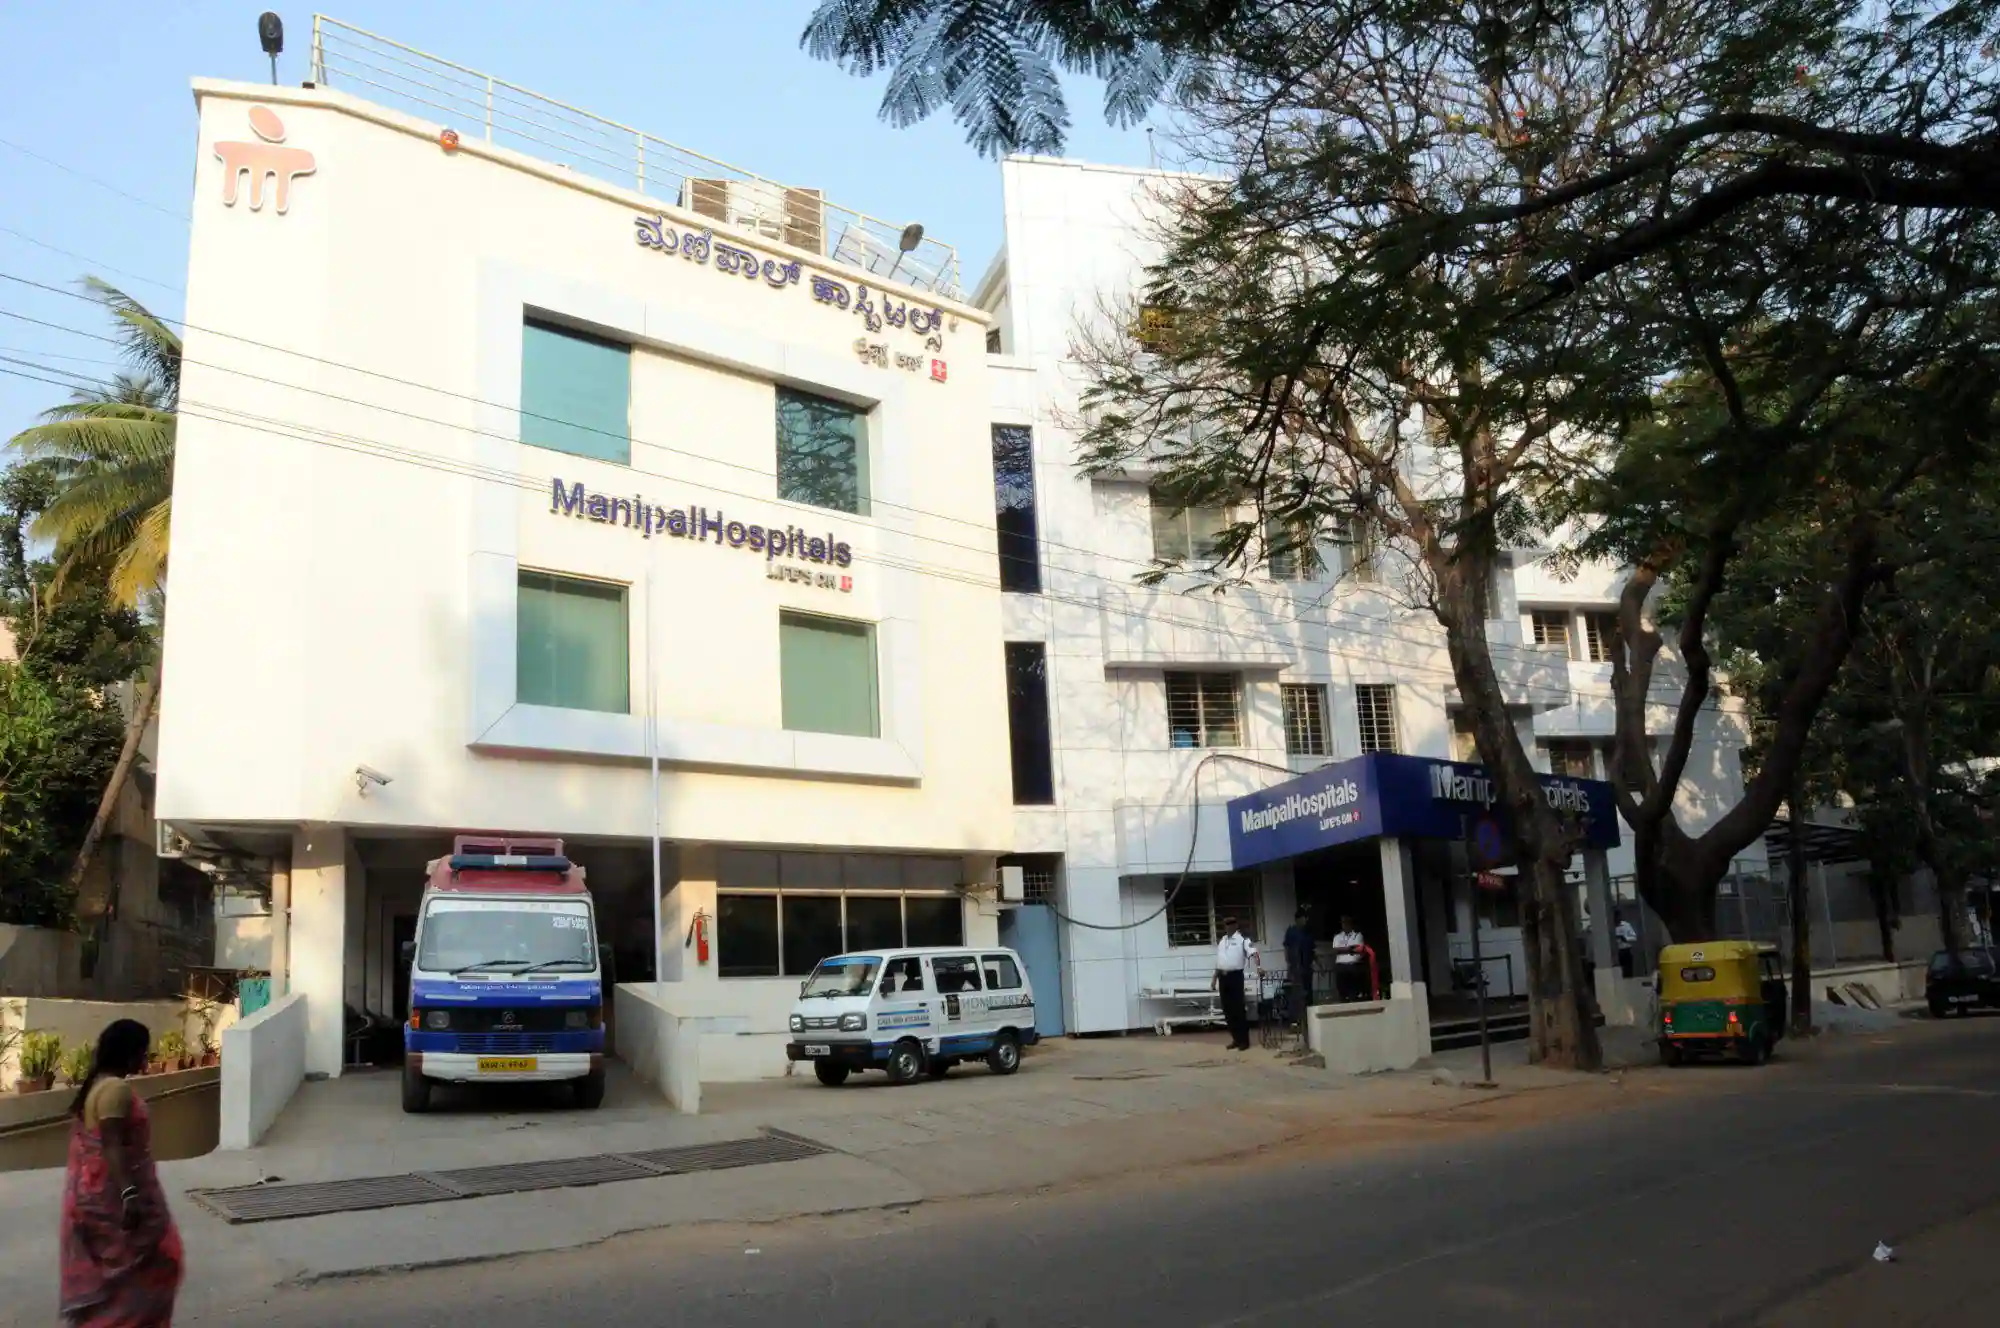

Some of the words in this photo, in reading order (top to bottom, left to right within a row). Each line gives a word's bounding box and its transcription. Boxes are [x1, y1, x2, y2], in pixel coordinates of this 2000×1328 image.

[634, 215, 803, 287] ಮಣಿಪಾಲ್
[551, 477, 852, 568] ManipalHospitals
[1241, 778, 1359, 834] ManipalHospitals
[1319, 814, 1341, 831] LIFE'S
[1341, 812, 1353, 826] ON
